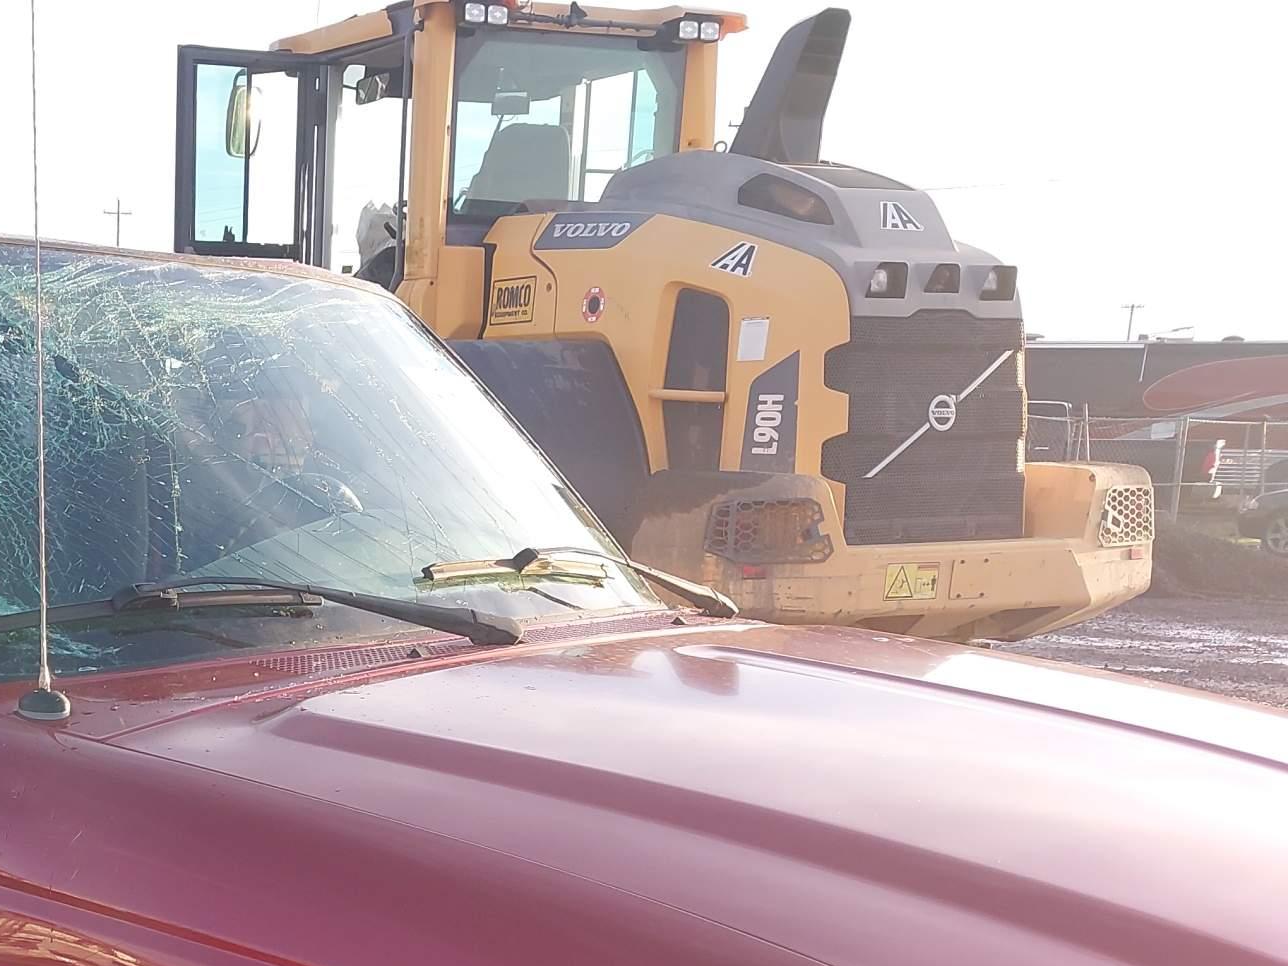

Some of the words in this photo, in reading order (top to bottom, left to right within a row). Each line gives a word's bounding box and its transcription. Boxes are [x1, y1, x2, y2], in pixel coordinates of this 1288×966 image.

[881, 202, 921, 230] IAA
[553, 222, 631, 238] VOLVO
[496, 284, 531, 310] ROMCO
[752, 394, 785, 455] L90H
